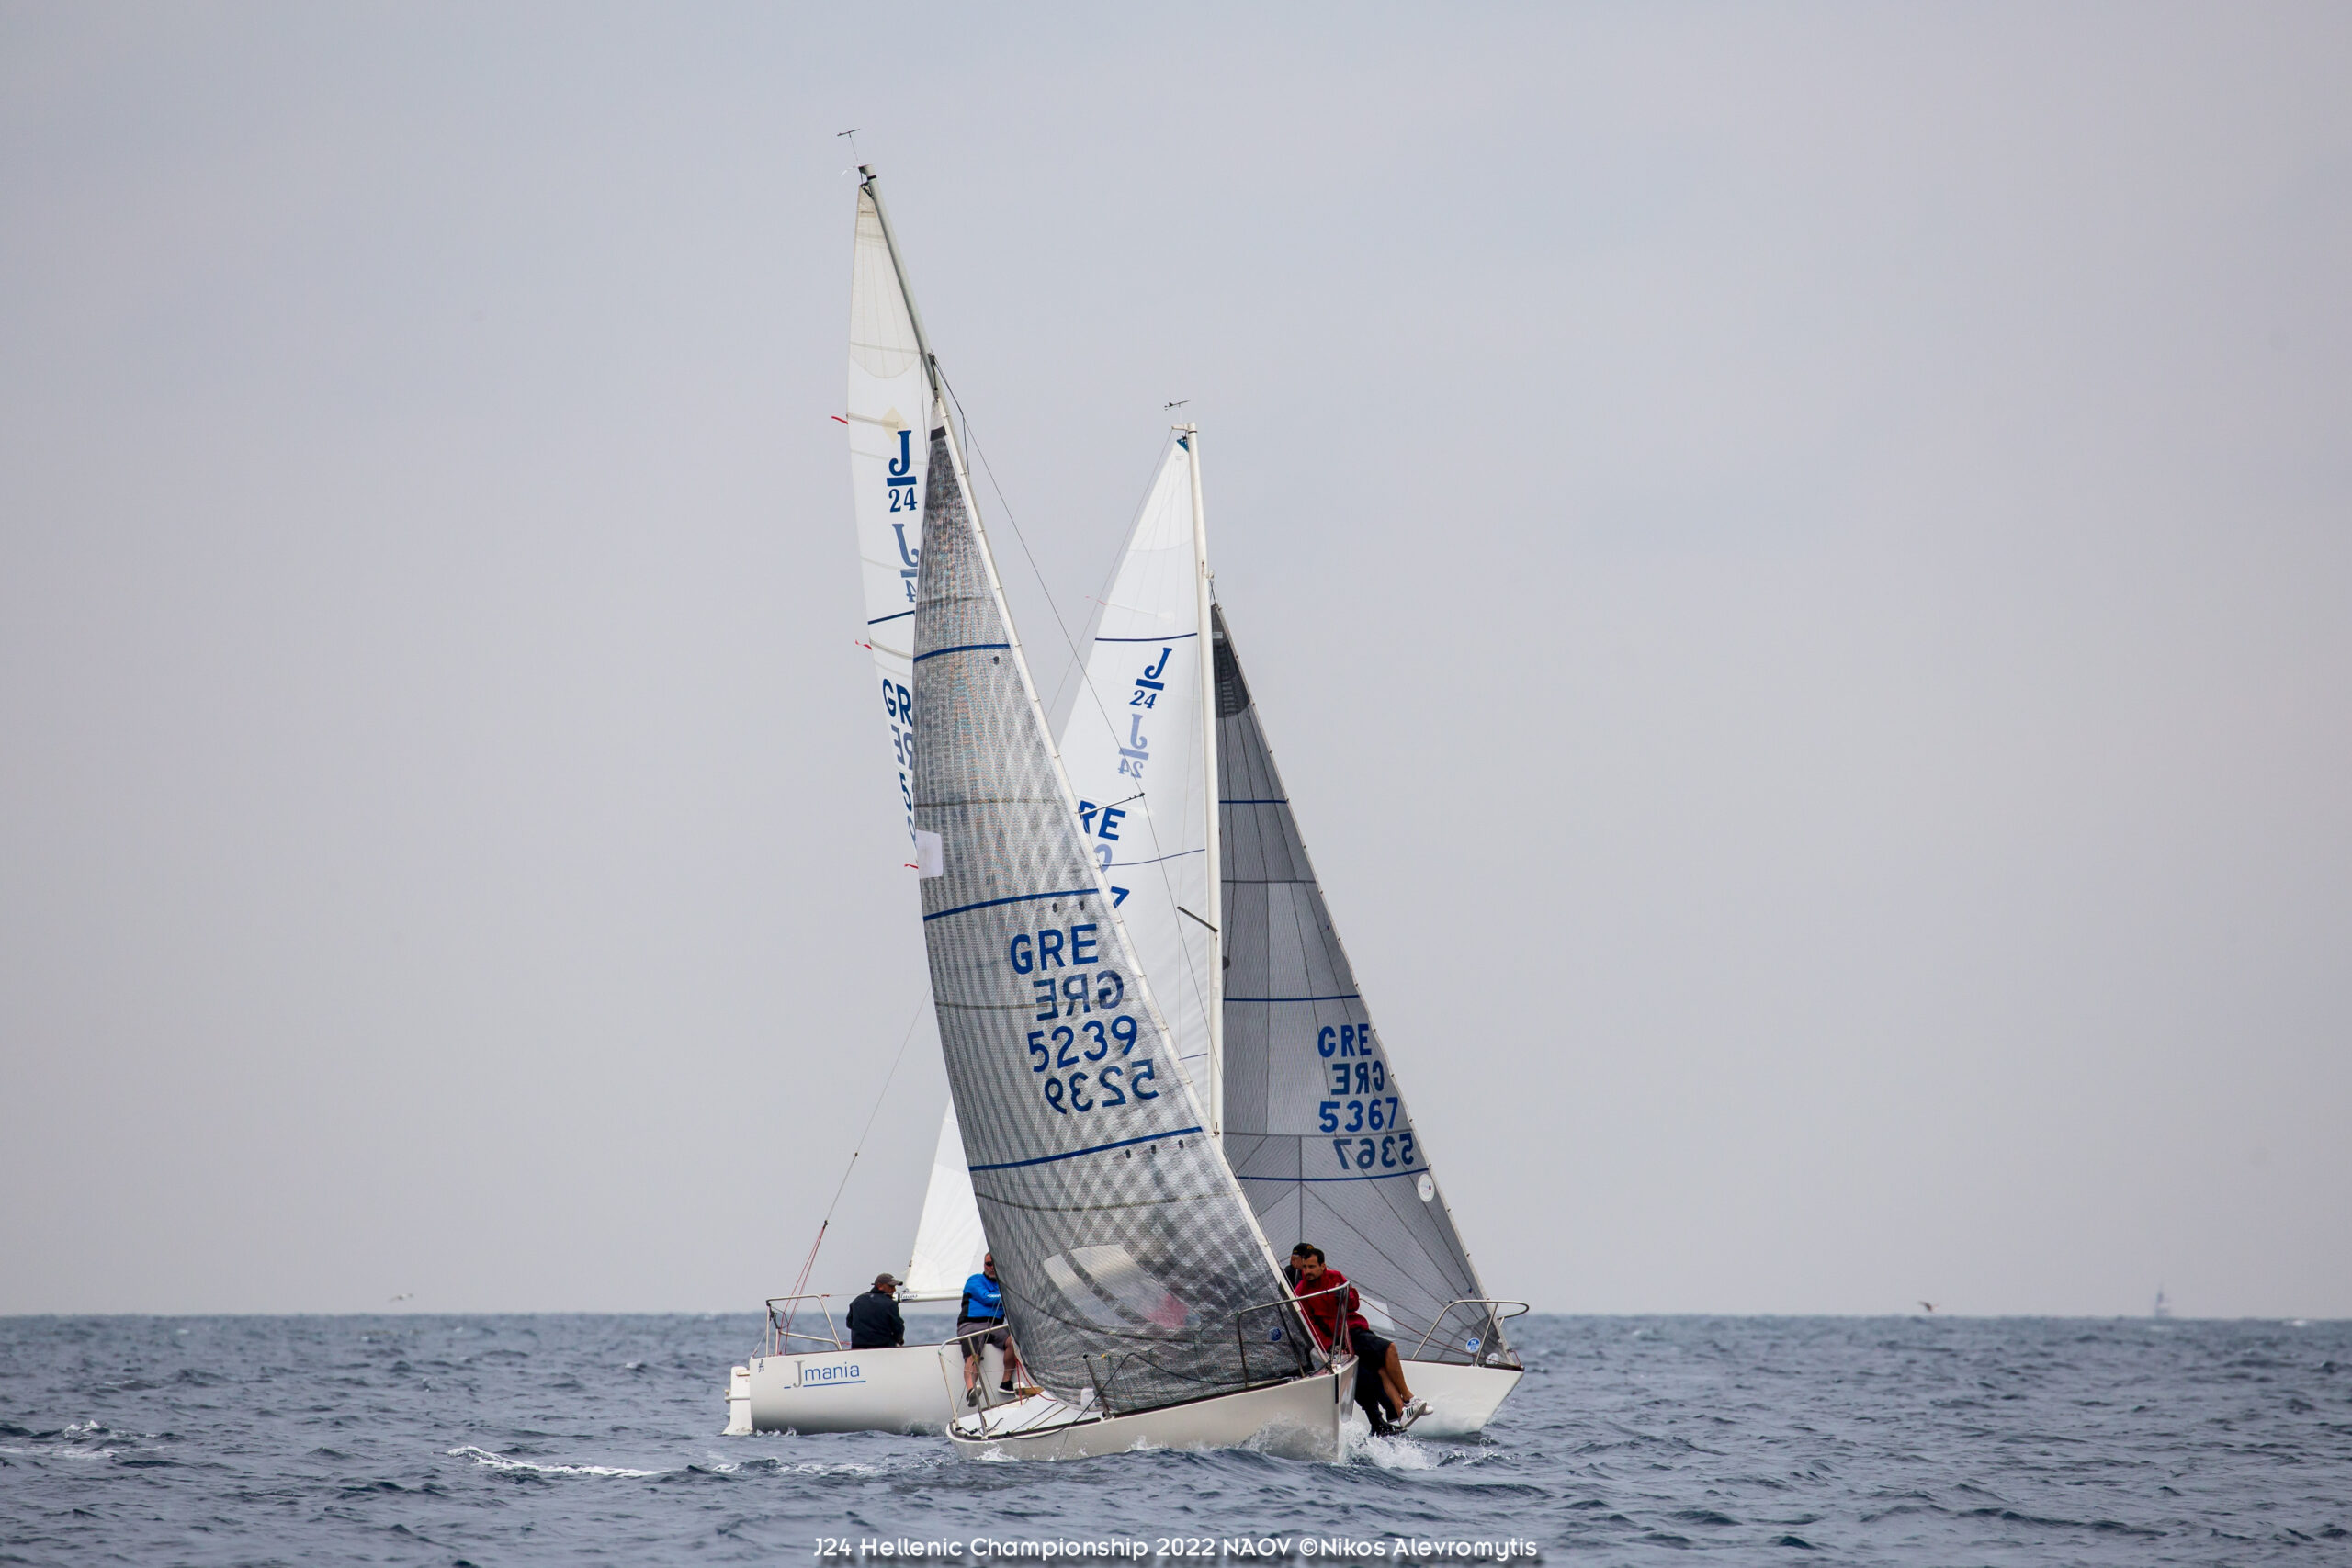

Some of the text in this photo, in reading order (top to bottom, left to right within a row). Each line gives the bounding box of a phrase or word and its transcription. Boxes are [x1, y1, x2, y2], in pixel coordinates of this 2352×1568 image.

[888, 430, 912, 476] J
[888, 487, 918, 513] 24
[1144, 647, 1173, 680] J
[882, 678, 913, 727] GR
[1129, 690, 1158, 709] 24
[1079, 800, 1126, 840] RE
[1011, 923, 1099, 975] GRE
[1027, 1015, 1137, 1073] 5239
[1317, 1023, 1373, 1058] GRE
[1318, 1097, 1399, 1134] 5367
